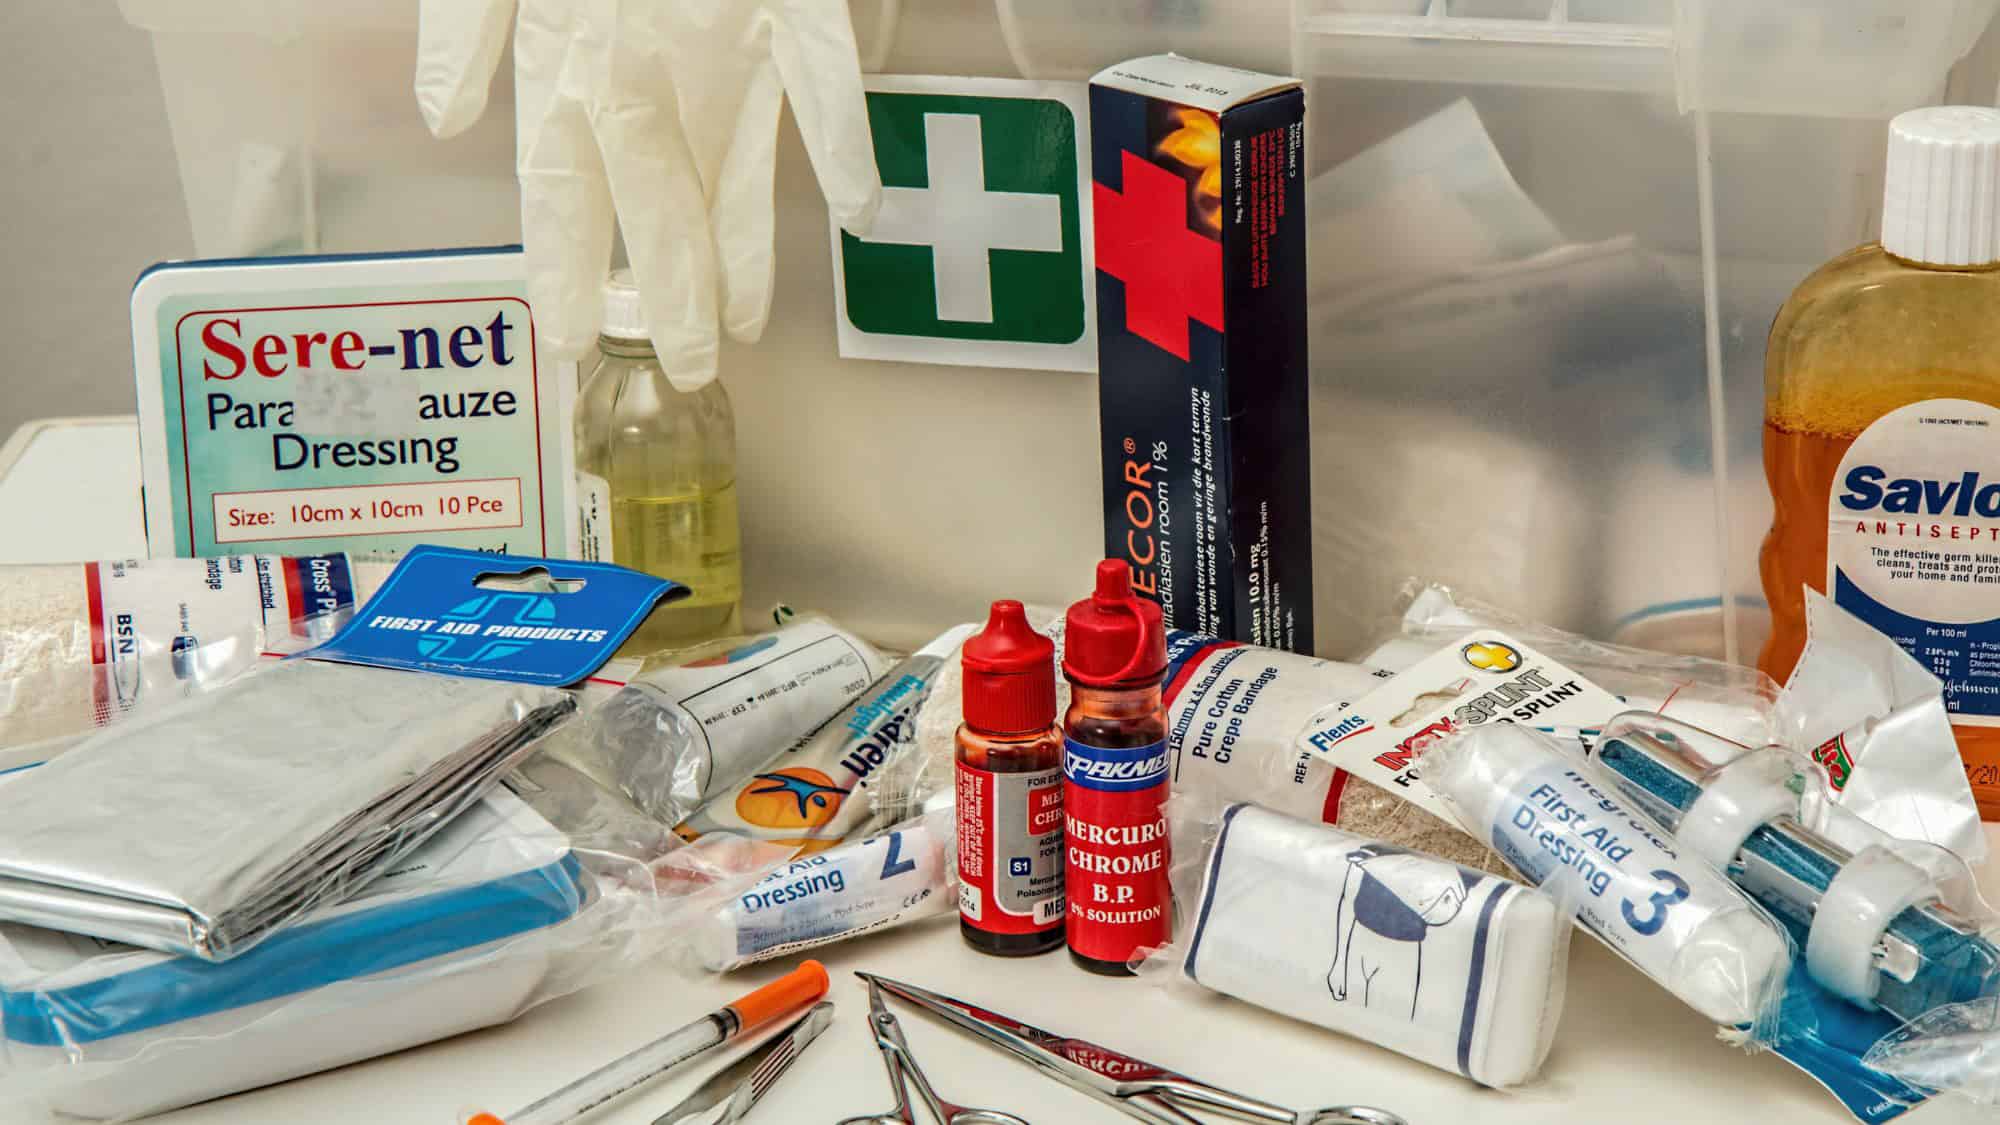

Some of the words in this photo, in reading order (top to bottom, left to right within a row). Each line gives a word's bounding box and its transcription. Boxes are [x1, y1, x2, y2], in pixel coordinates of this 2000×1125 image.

[201, 311, 514, 381] Sere-net
[272, 433, 460, 474] Dressing
[1191, 438, 1201, 466] kort
[228, 508, 276, 527] Size:
[290, 504, 344, 523] 10cm
[350, 508, 363, 521] x
[371, 500, 424, 519] 10cm
[438, 497, 460, 515] 10
[467, 495, 503, 514] Pce
[1158, 482, 1170, 536] room
[1250, 543, 1261, 569] mg
[1871, 547, 1890, 558] The
[1894, 549, 1940, 561] effective
[1944, 552, 1971, 563] germ
[1877, 559, 1915, 571] cleans,
[1918, 560, 1950, 571] treats
[1953, 562, 1973, 573] and
[1890, 570, 1913, 582] your
[1918, 570, 1946, 581] home
[1951, 571, 1970, 583] and
[117, 614, 134, 654] BSN
[368, 615, 437, 632] FIRST
[437, 622, 480, 636] AID
[483, 624, 608, 642] PRODUCTS
[1214, 718, 1243, 764] Crepe
[1233, 666, 1278, 715] Bandage
[1513, 680, 1584, 722] SPLINT
[1169, 706, 1194, 750] 150mm
[1192, 721, 1217, 759] Pure
[1208, 678, 1244, 719] Cotton
[1308, 714, 1366, 753] Flents
[1027, 776, 1046, 788] FOR
[1294, 761, 1308, 784] REF
[1529, 784, 1587, 829] First
[1581, 826, 1633, 863] Aid
[1012, 861, 1028, 872] S1
[1069, 847, 1161, 875] CHROME
[1512, 804, 1613, 897] Dressing
[1621, 869, 1691, 936] 3
[741, 869, 845, 913] Dressing
[1093, 883, 1135, 904] B.P.
[1087, 905, 1161, 924] SOLUTION
